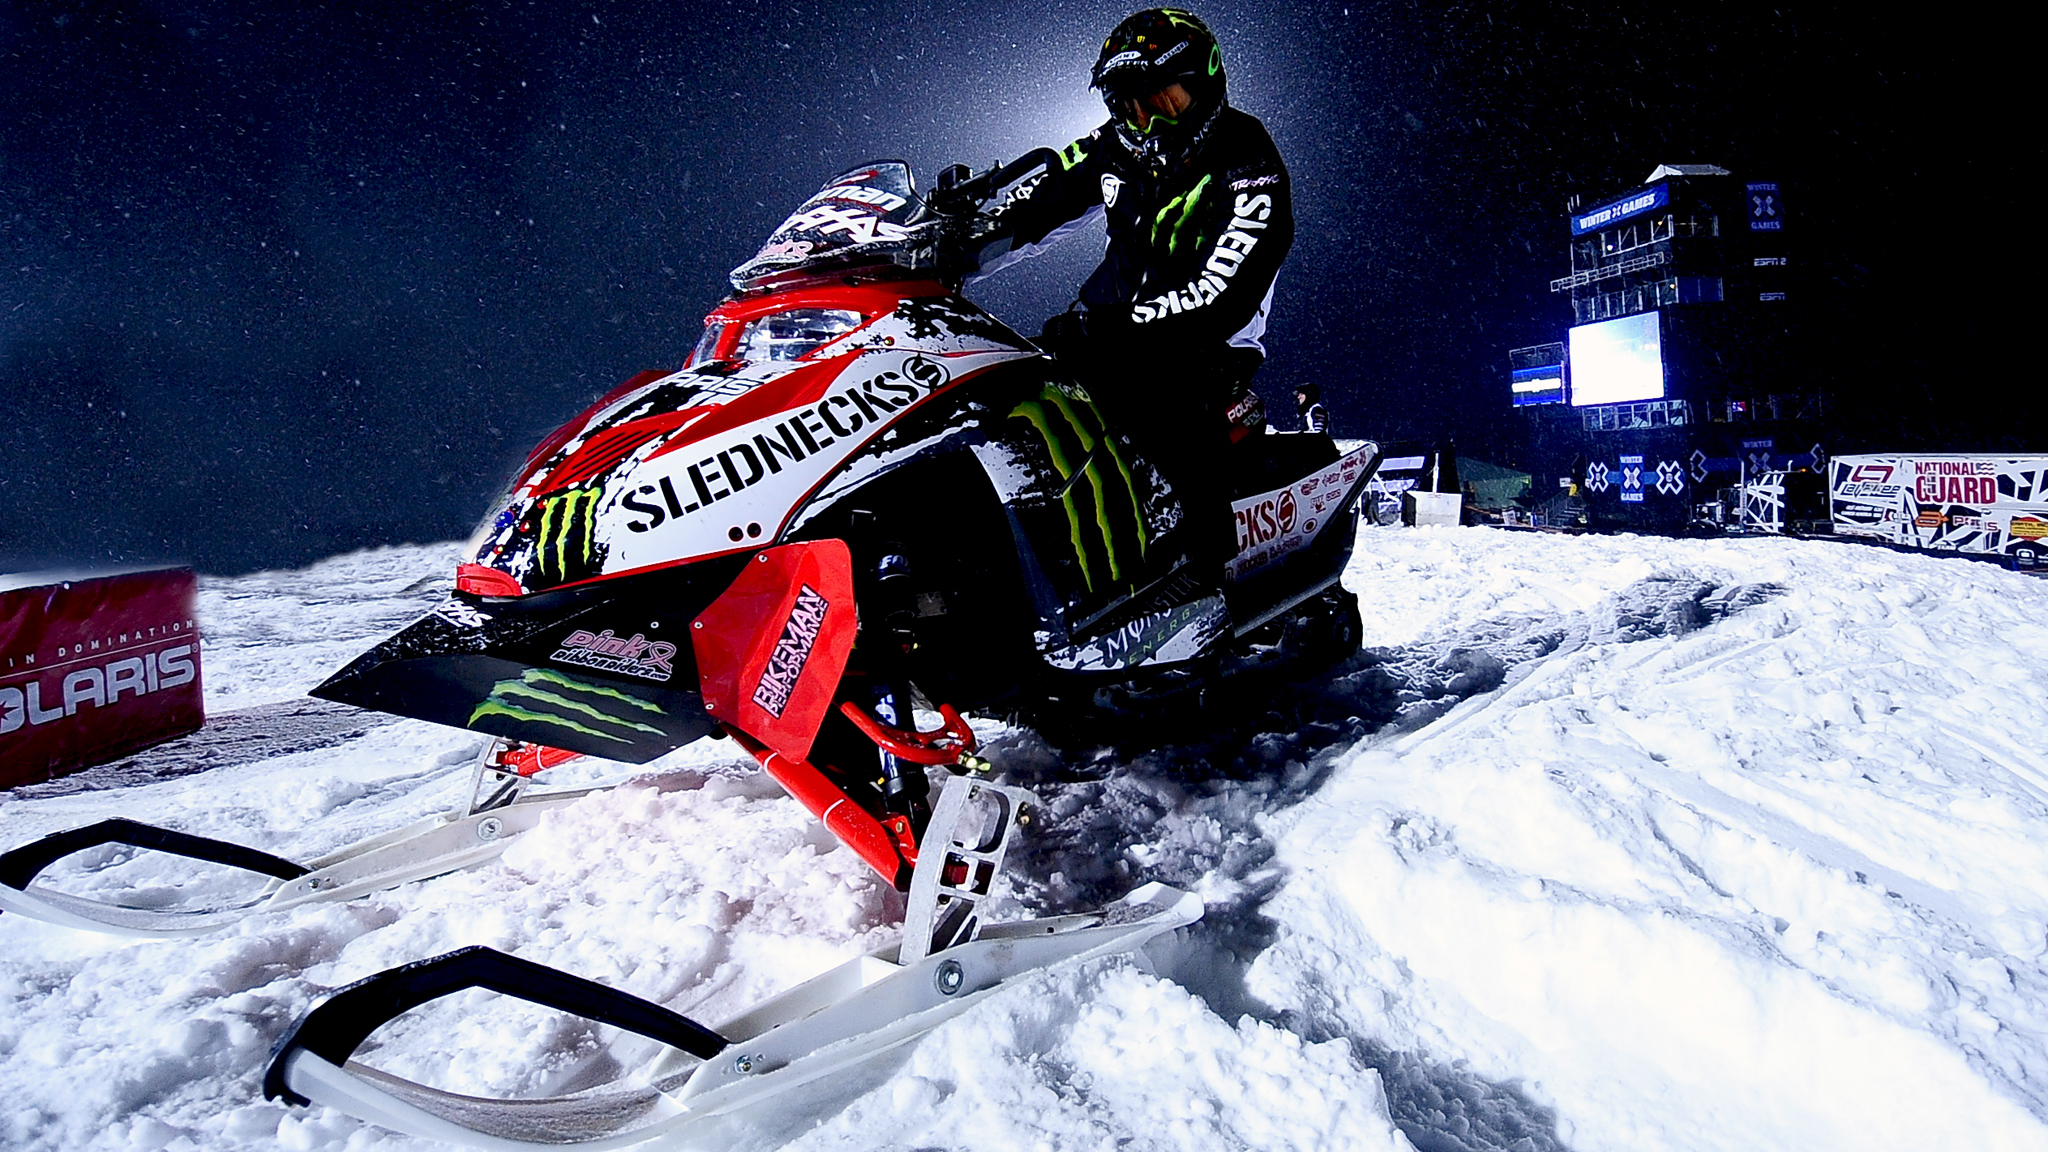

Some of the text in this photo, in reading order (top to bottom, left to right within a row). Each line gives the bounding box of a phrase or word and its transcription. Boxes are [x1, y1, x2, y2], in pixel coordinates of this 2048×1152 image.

[1580, 210, 1612, 230] WINTER
[1622, 193, 1655, 215] GAMES
[1760, 292, 1785, 301] ESPN
[624, 371, 920, 533] SLEDNECKS
[1915, 462, 1976, 475] NATIONAL
[1916, 476, 1997, 504] GUARD
[9, 619, 194, 668] IN DOMINATION
[752, 585, 821, 718] BIKEMAN
[1128, 599, 1201, 665] ENERGY
